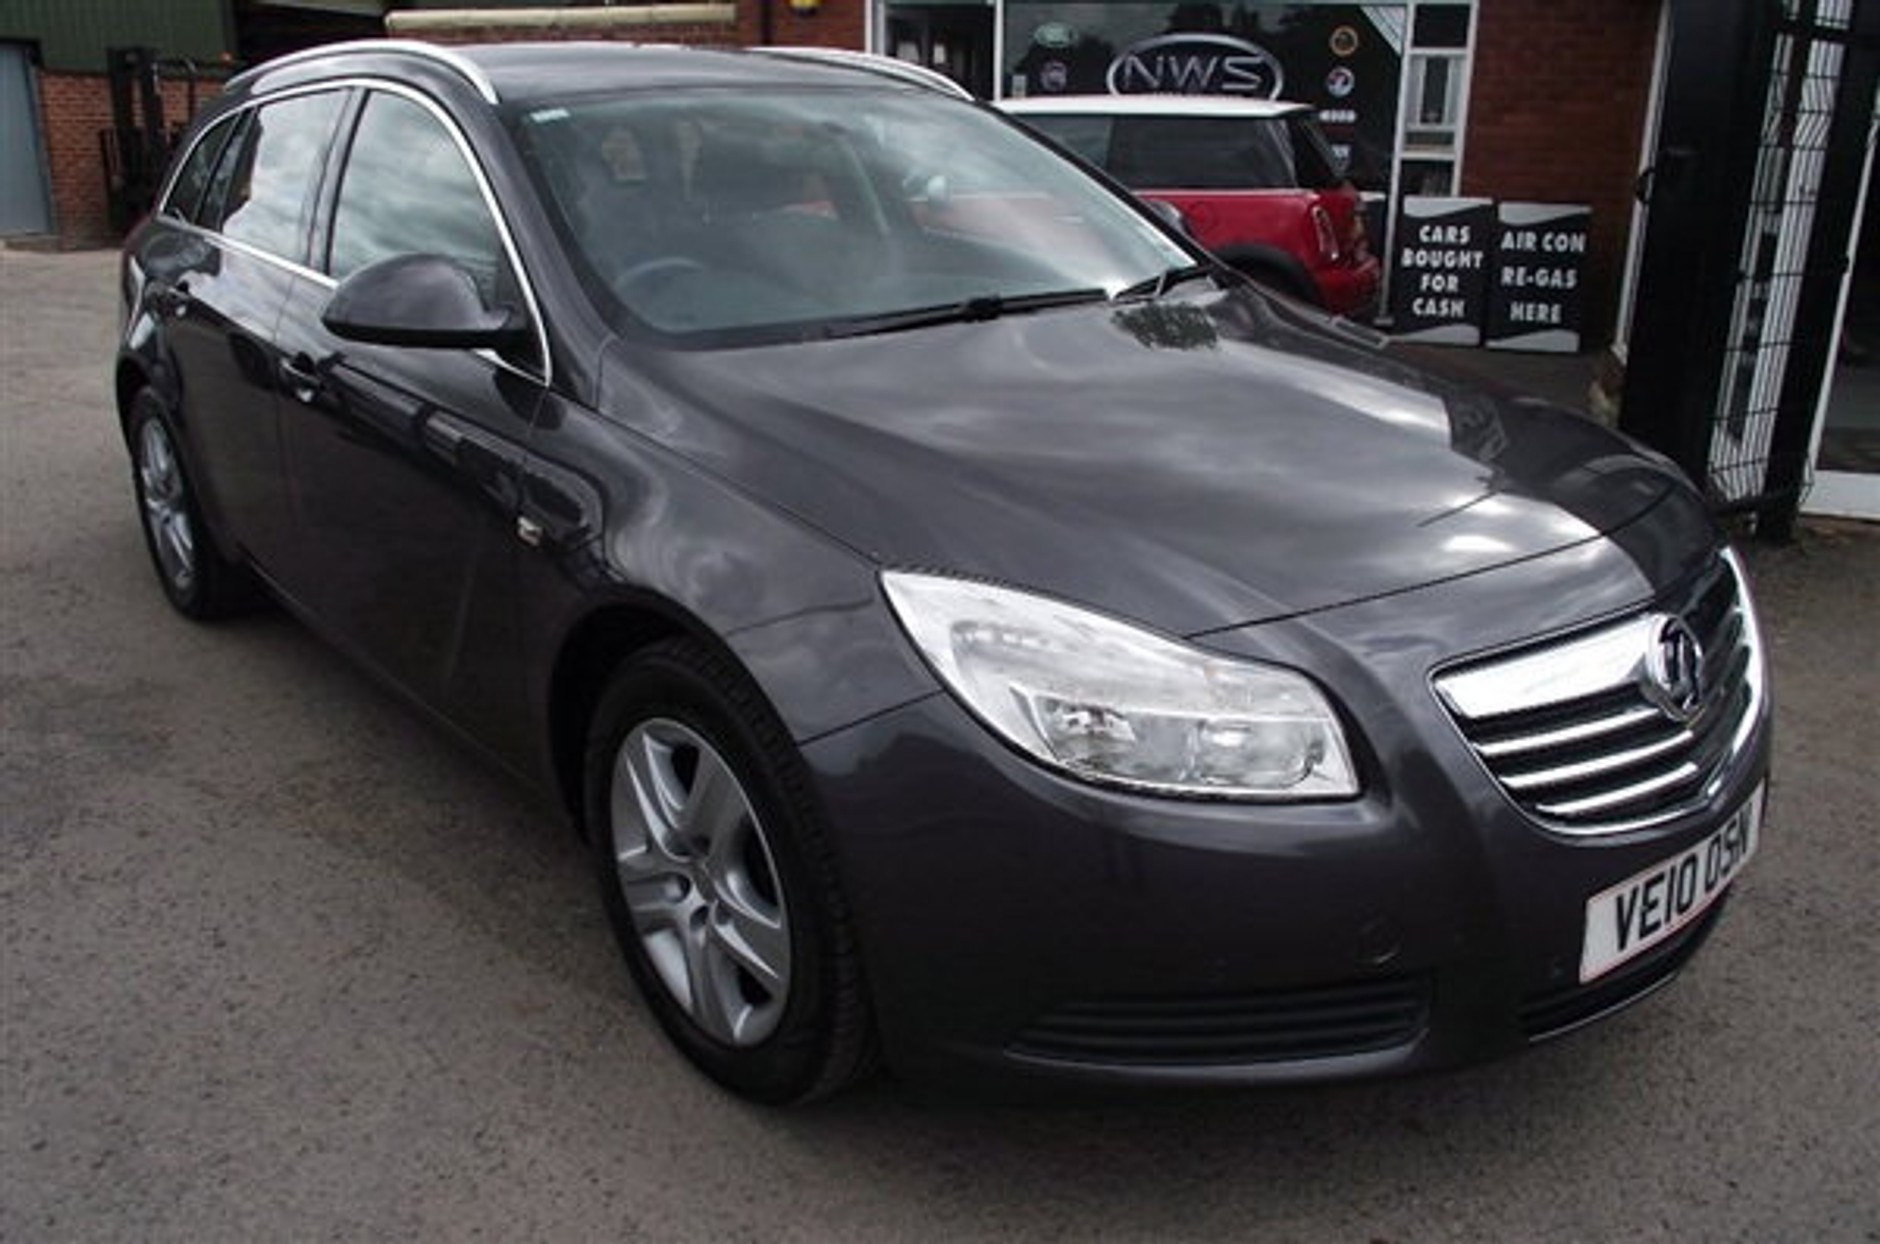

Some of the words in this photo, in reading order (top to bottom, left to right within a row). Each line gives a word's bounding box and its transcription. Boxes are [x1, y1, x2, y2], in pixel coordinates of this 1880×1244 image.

[1124, 56, 1264, 90] NWS
[1419, 225, 1470, 244] CARS
[1501, 231, 1537, 251] AIR
[1542, 233, 1587, 252] CON
[1402, 248, 1484, 268] BOUGHT
[1420, 274, 1459, 292] FOR
[1501, 266, 1578, 289] RE-GAS
[1413, 298, 1465, 317] CASH
[1510, 301, 1562, 323] HERE
[1616, 852, 1699, 951] VE10
